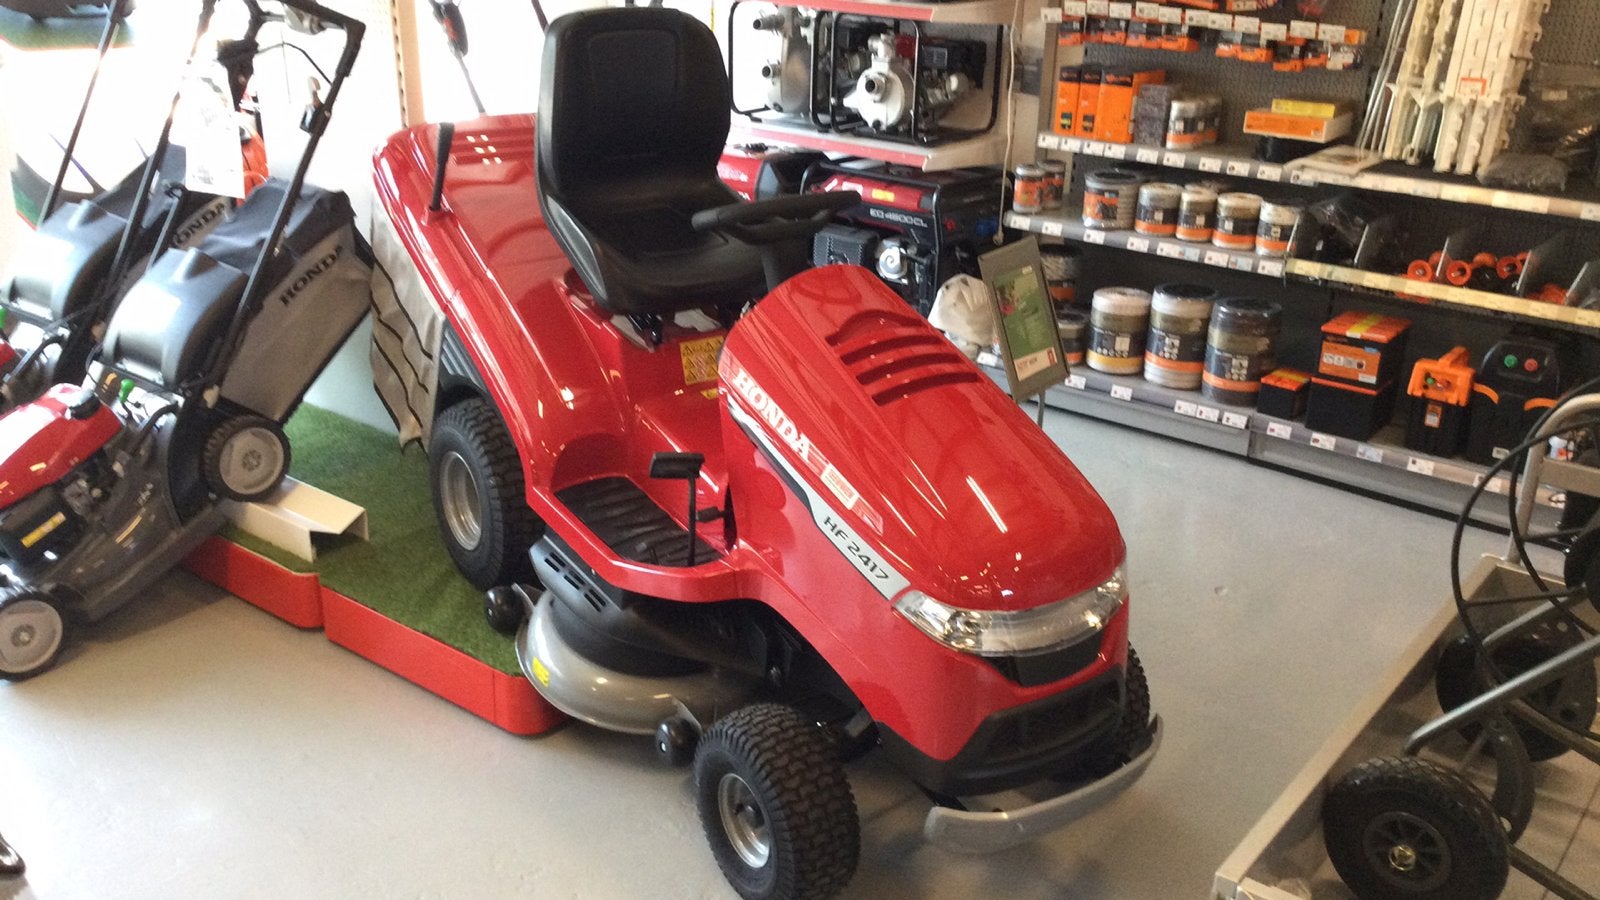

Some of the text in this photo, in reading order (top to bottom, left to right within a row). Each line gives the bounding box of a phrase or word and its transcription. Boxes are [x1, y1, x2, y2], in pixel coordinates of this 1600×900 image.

[176, 202, 225, 245] ONDA
[731, 366, 810, 463] HONDA
[823, 516, 890, 579] HF 2417
